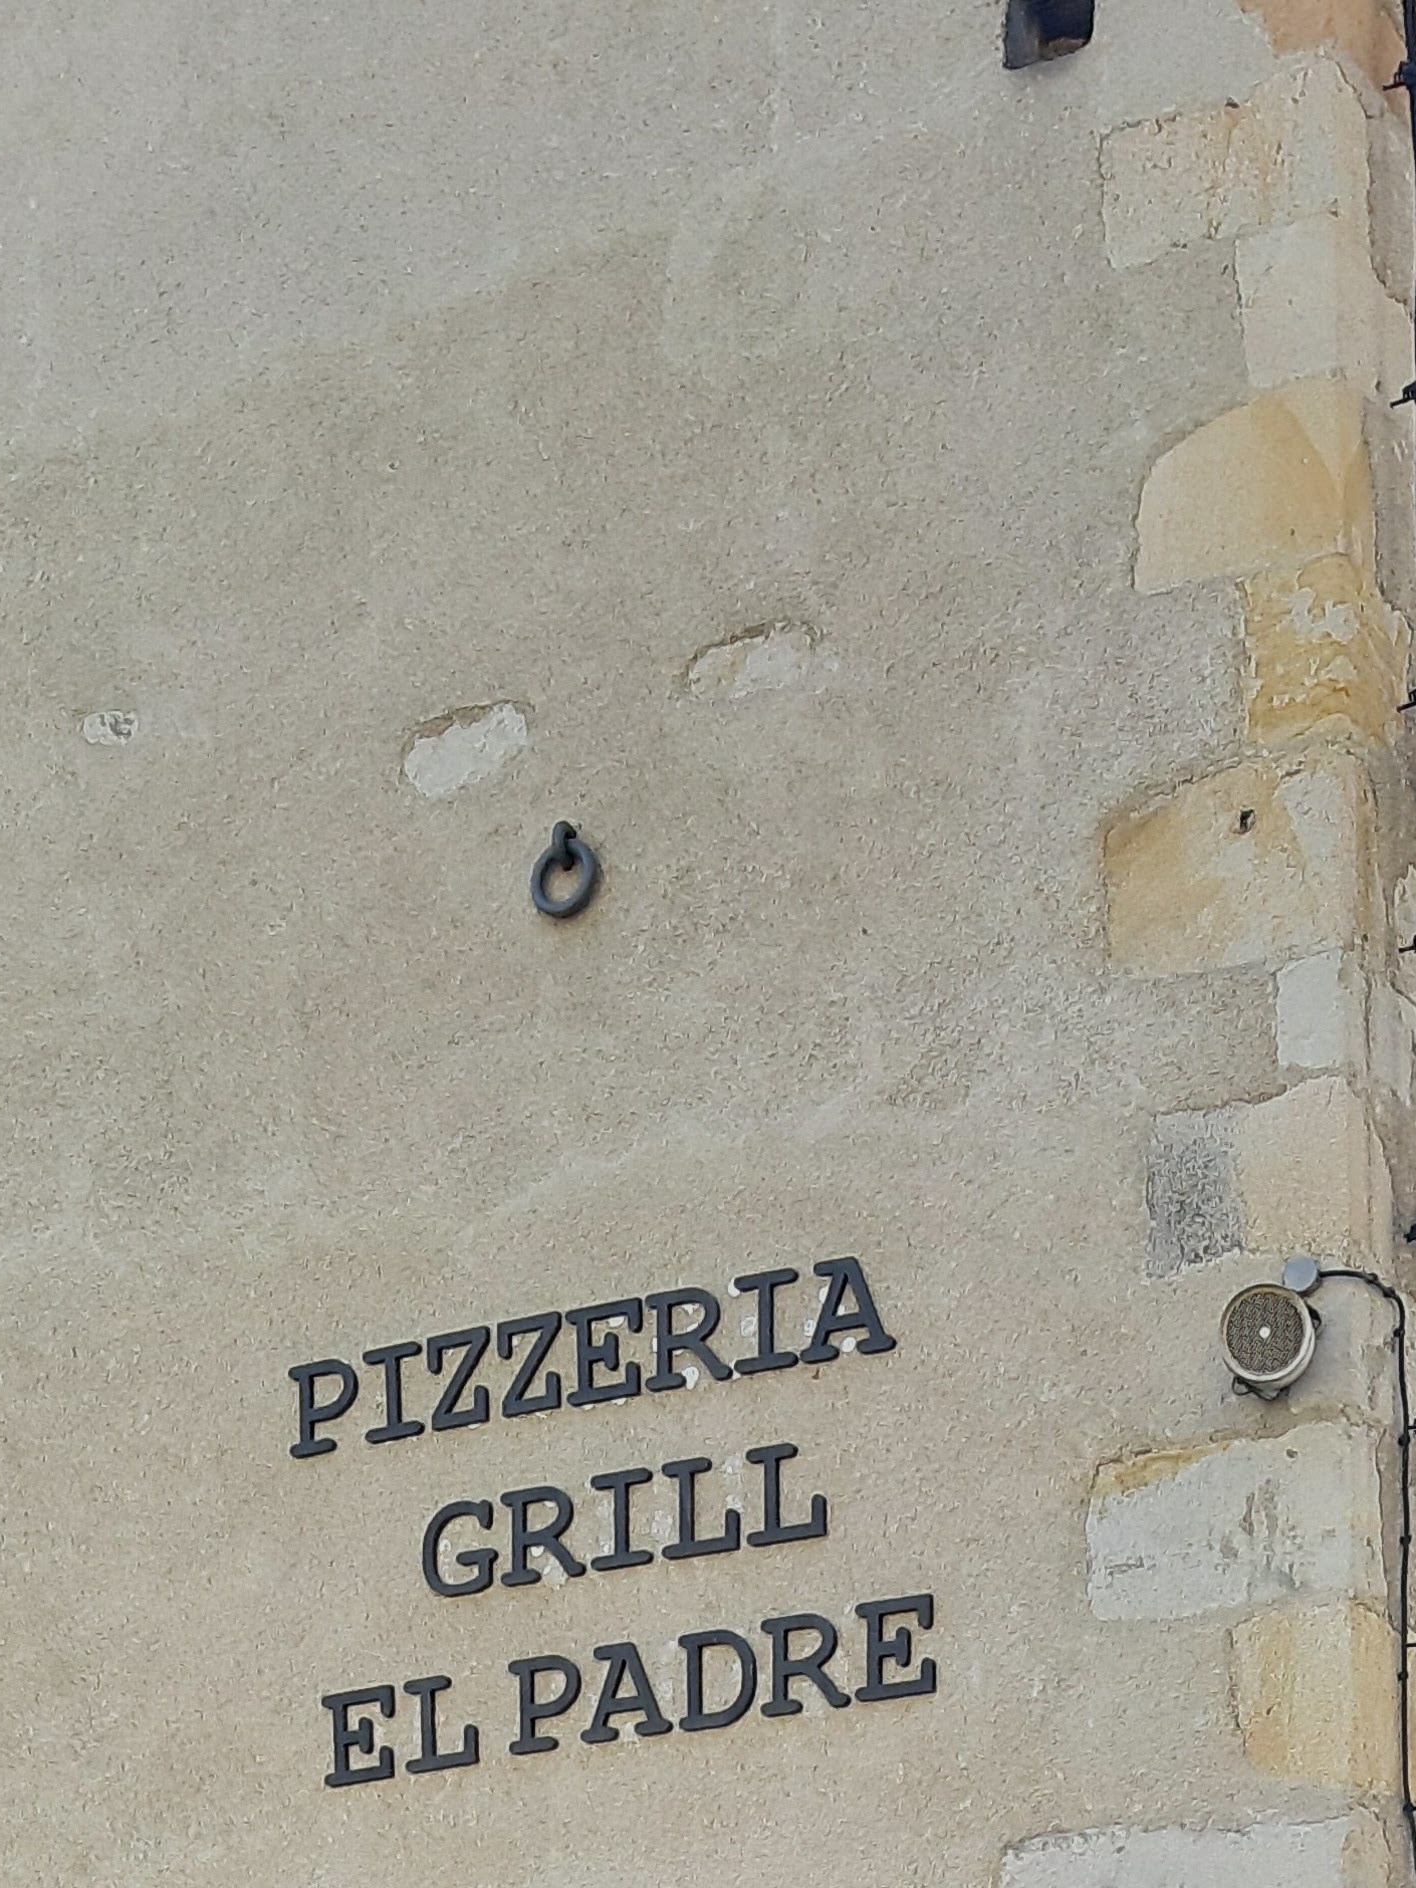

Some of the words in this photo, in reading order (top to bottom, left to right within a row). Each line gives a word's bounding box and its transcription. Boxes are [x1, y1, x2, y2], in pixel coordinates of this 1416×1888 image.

[287, 1256, 896, 1458] PIZZERIA
[421, 1442, 827, 1597] GRILL
[321, 1675, 479, 1788] EL
[508, 1594, 936, 1755] PADRE
